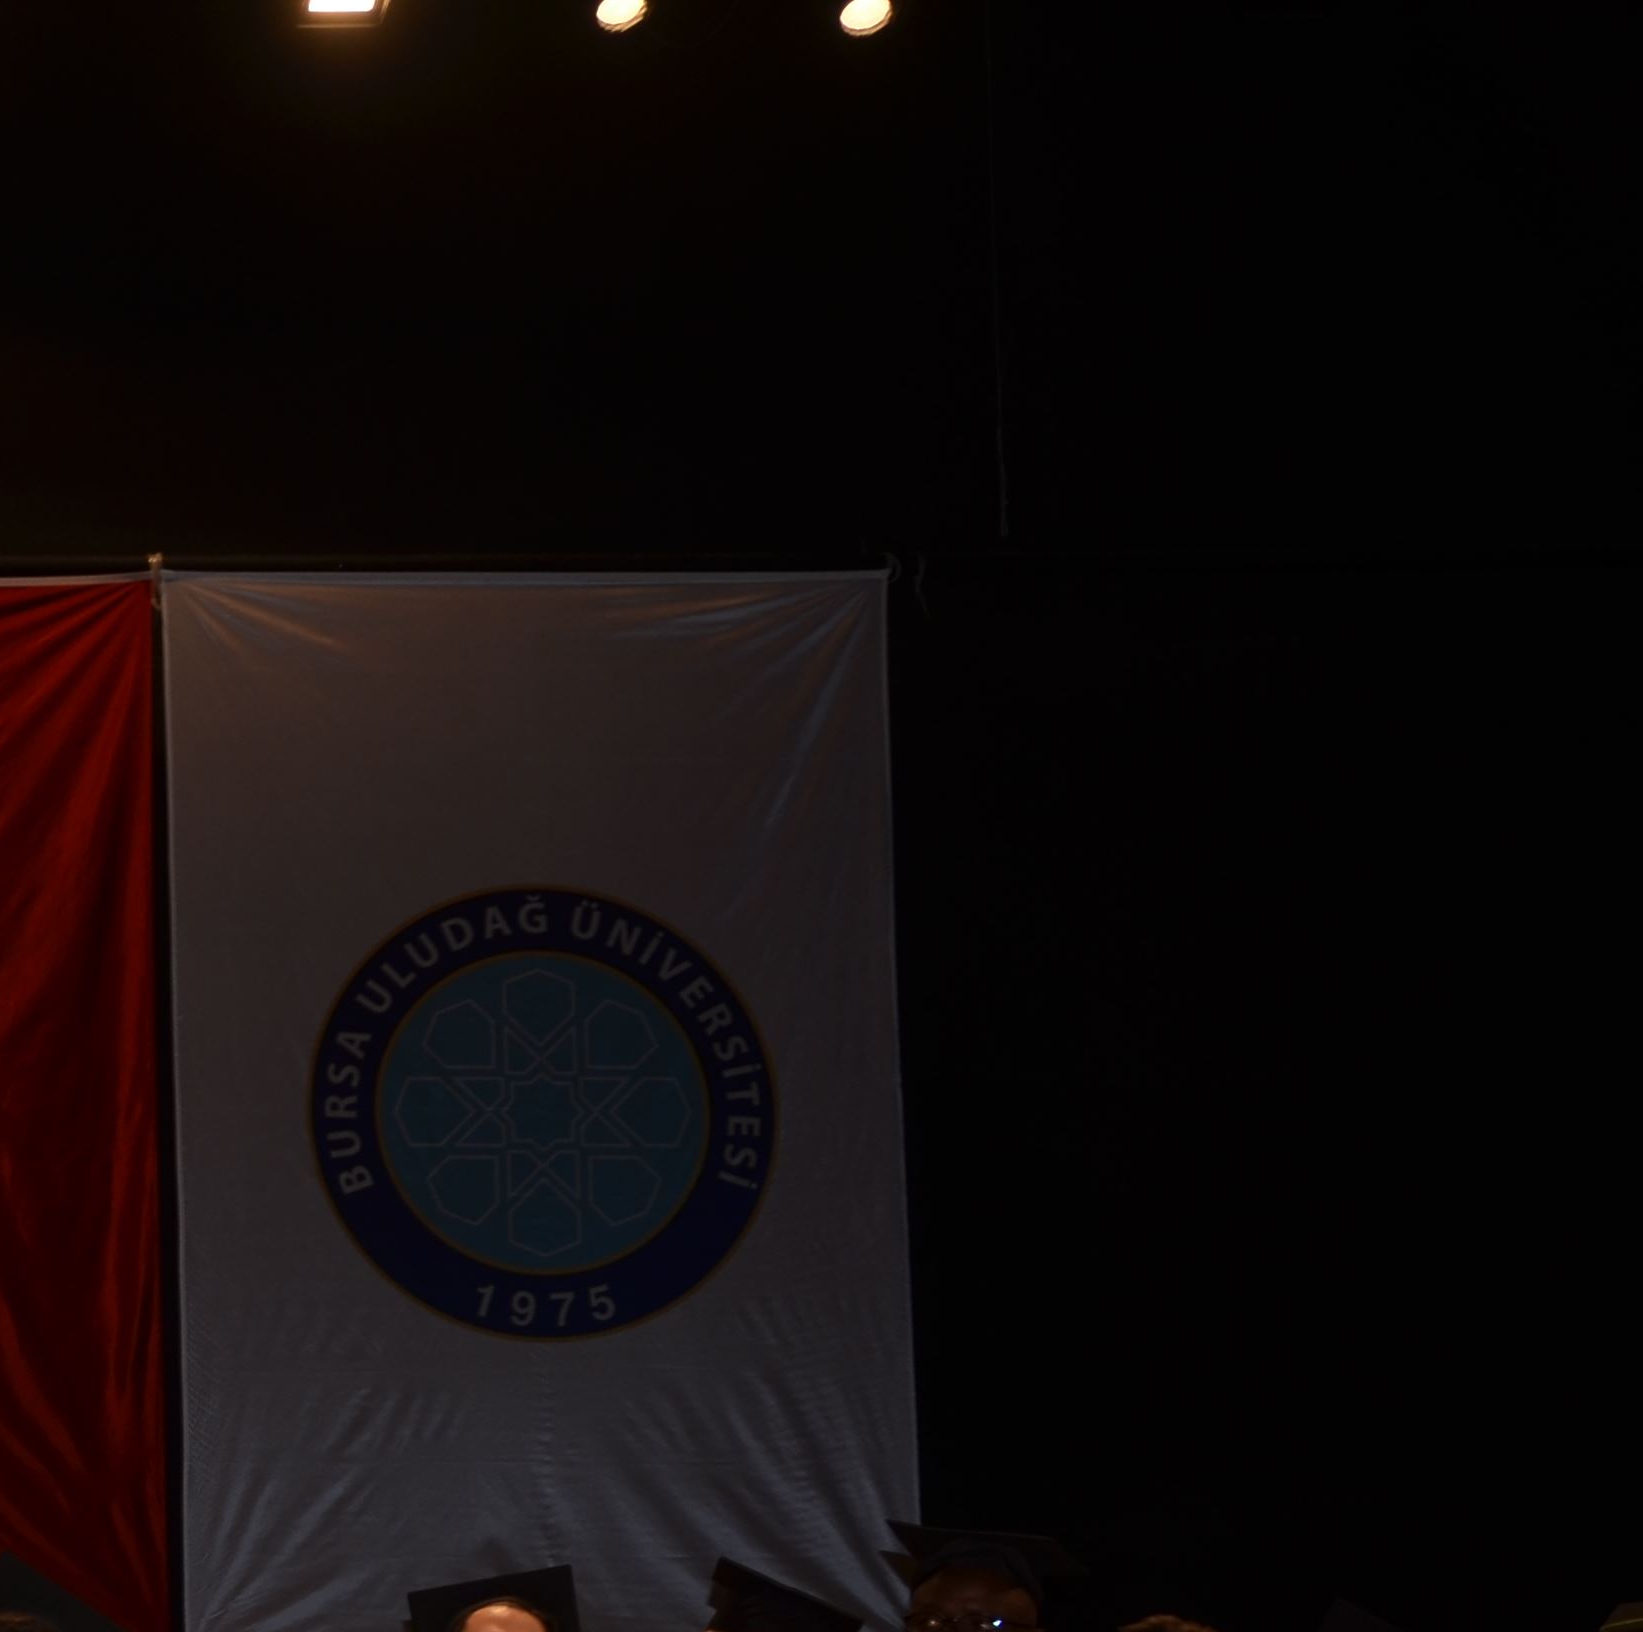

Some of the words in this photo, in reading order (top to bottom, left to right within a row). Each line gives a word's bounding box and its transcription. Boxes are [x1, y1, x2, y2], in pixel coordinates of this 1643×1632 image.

[325, 1029, 375, 1195] BURSA
[354, 894, 548, 1015] ULUDAĞ
[570, 900, 762, 1191] ÜNİVERSİTESİ
[474, 1283, 616, 1327] 1975
